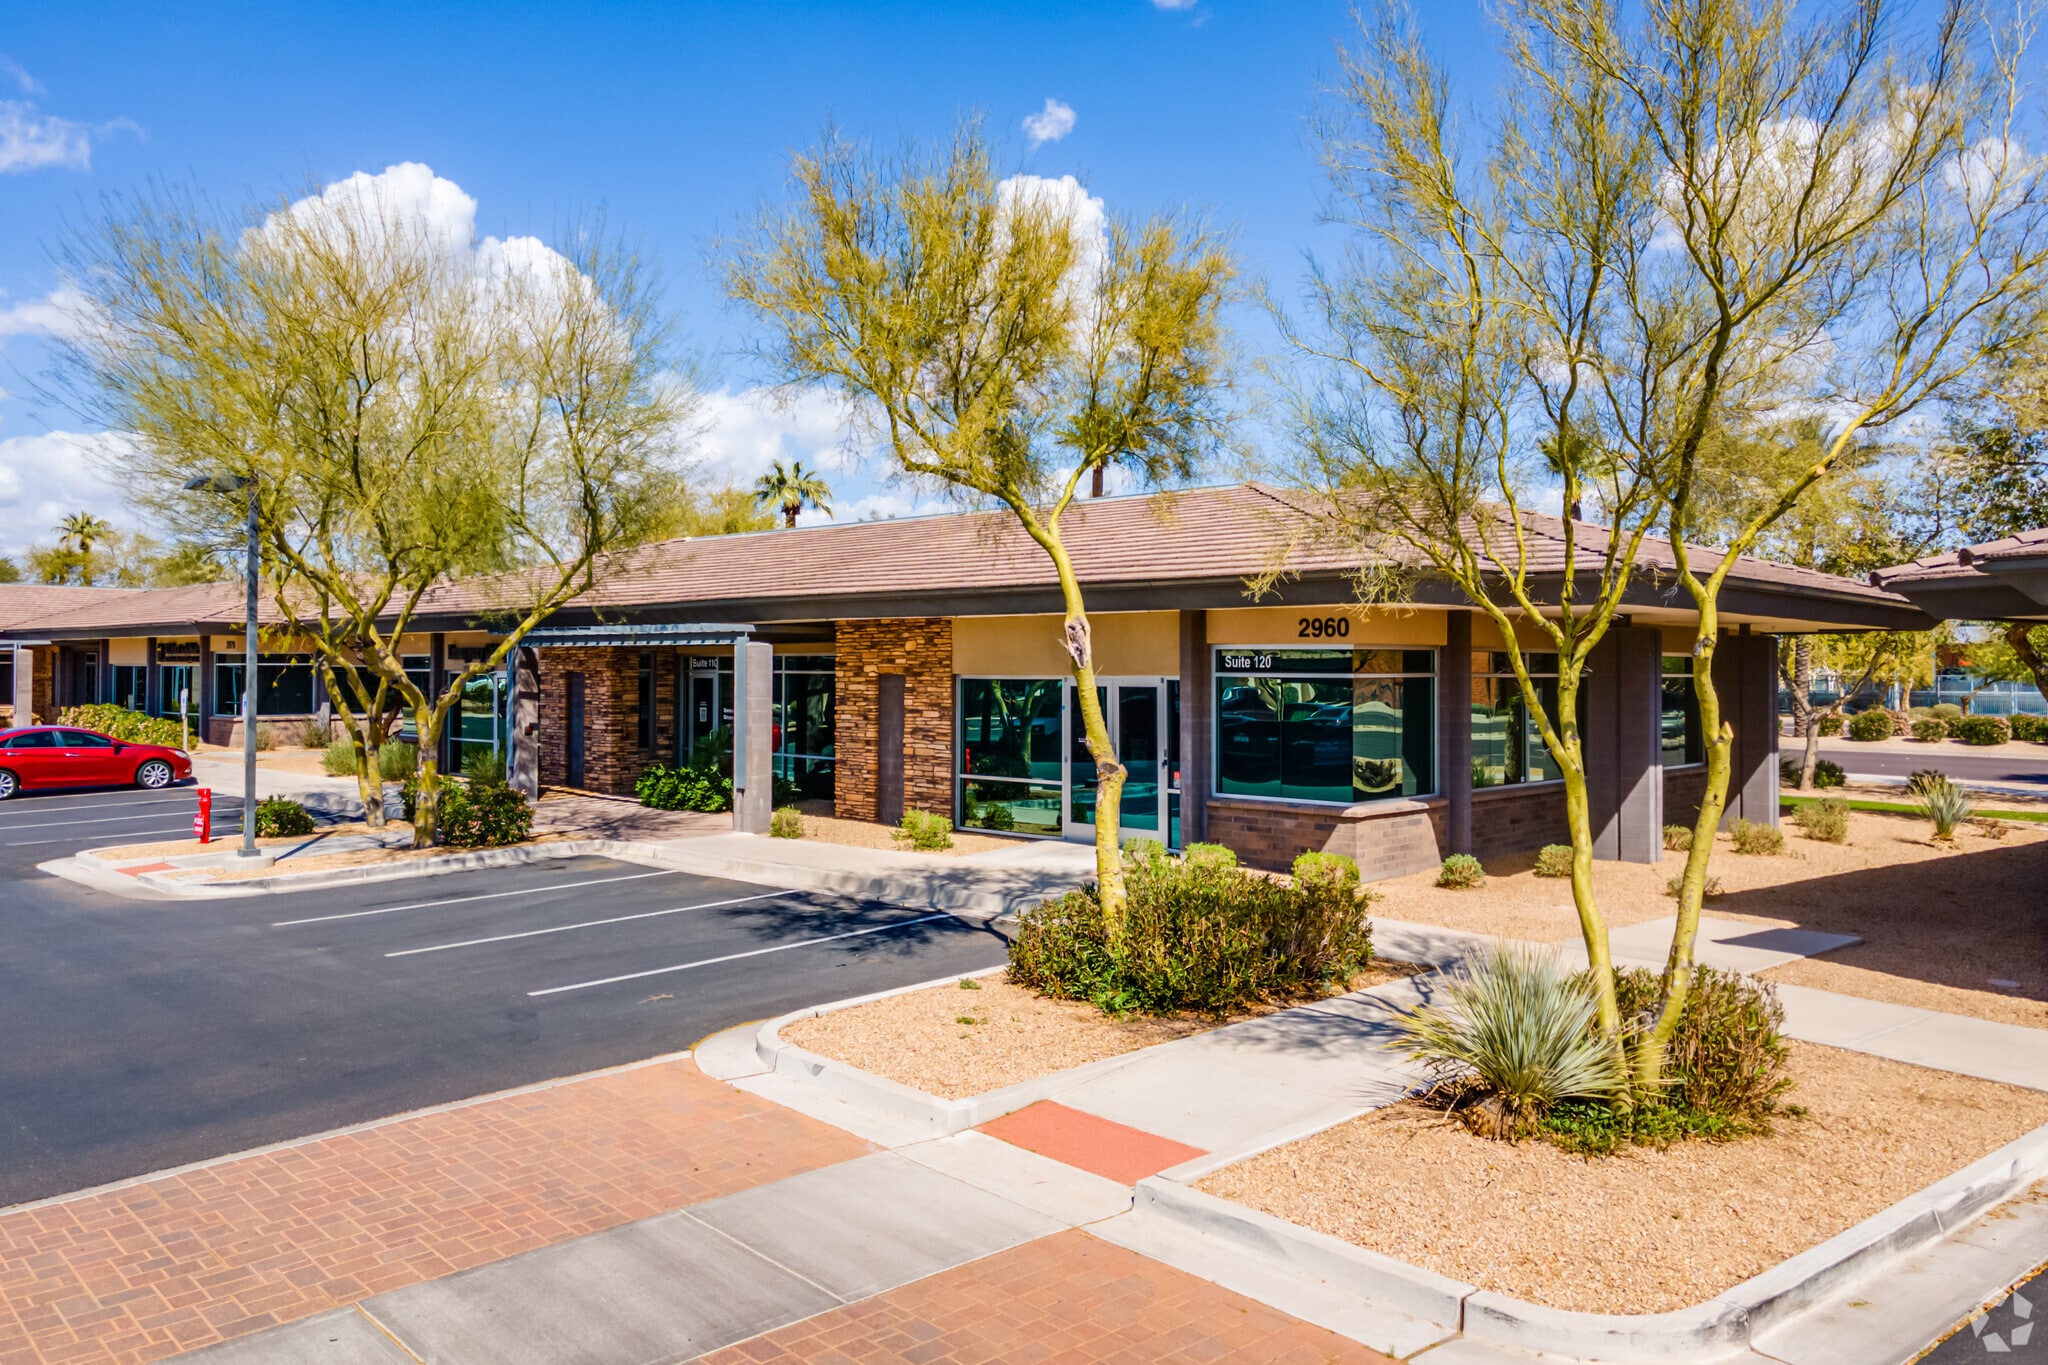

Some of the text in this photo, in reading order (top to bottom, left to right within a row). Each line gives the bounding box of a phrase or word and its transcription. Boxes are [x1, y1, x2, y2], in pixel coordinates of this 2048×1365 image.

[1298, 617, 1350, 638] 2960
[692, 658, 708, 668] Suite
[1225, 656, 1272, 669] Suite 120
